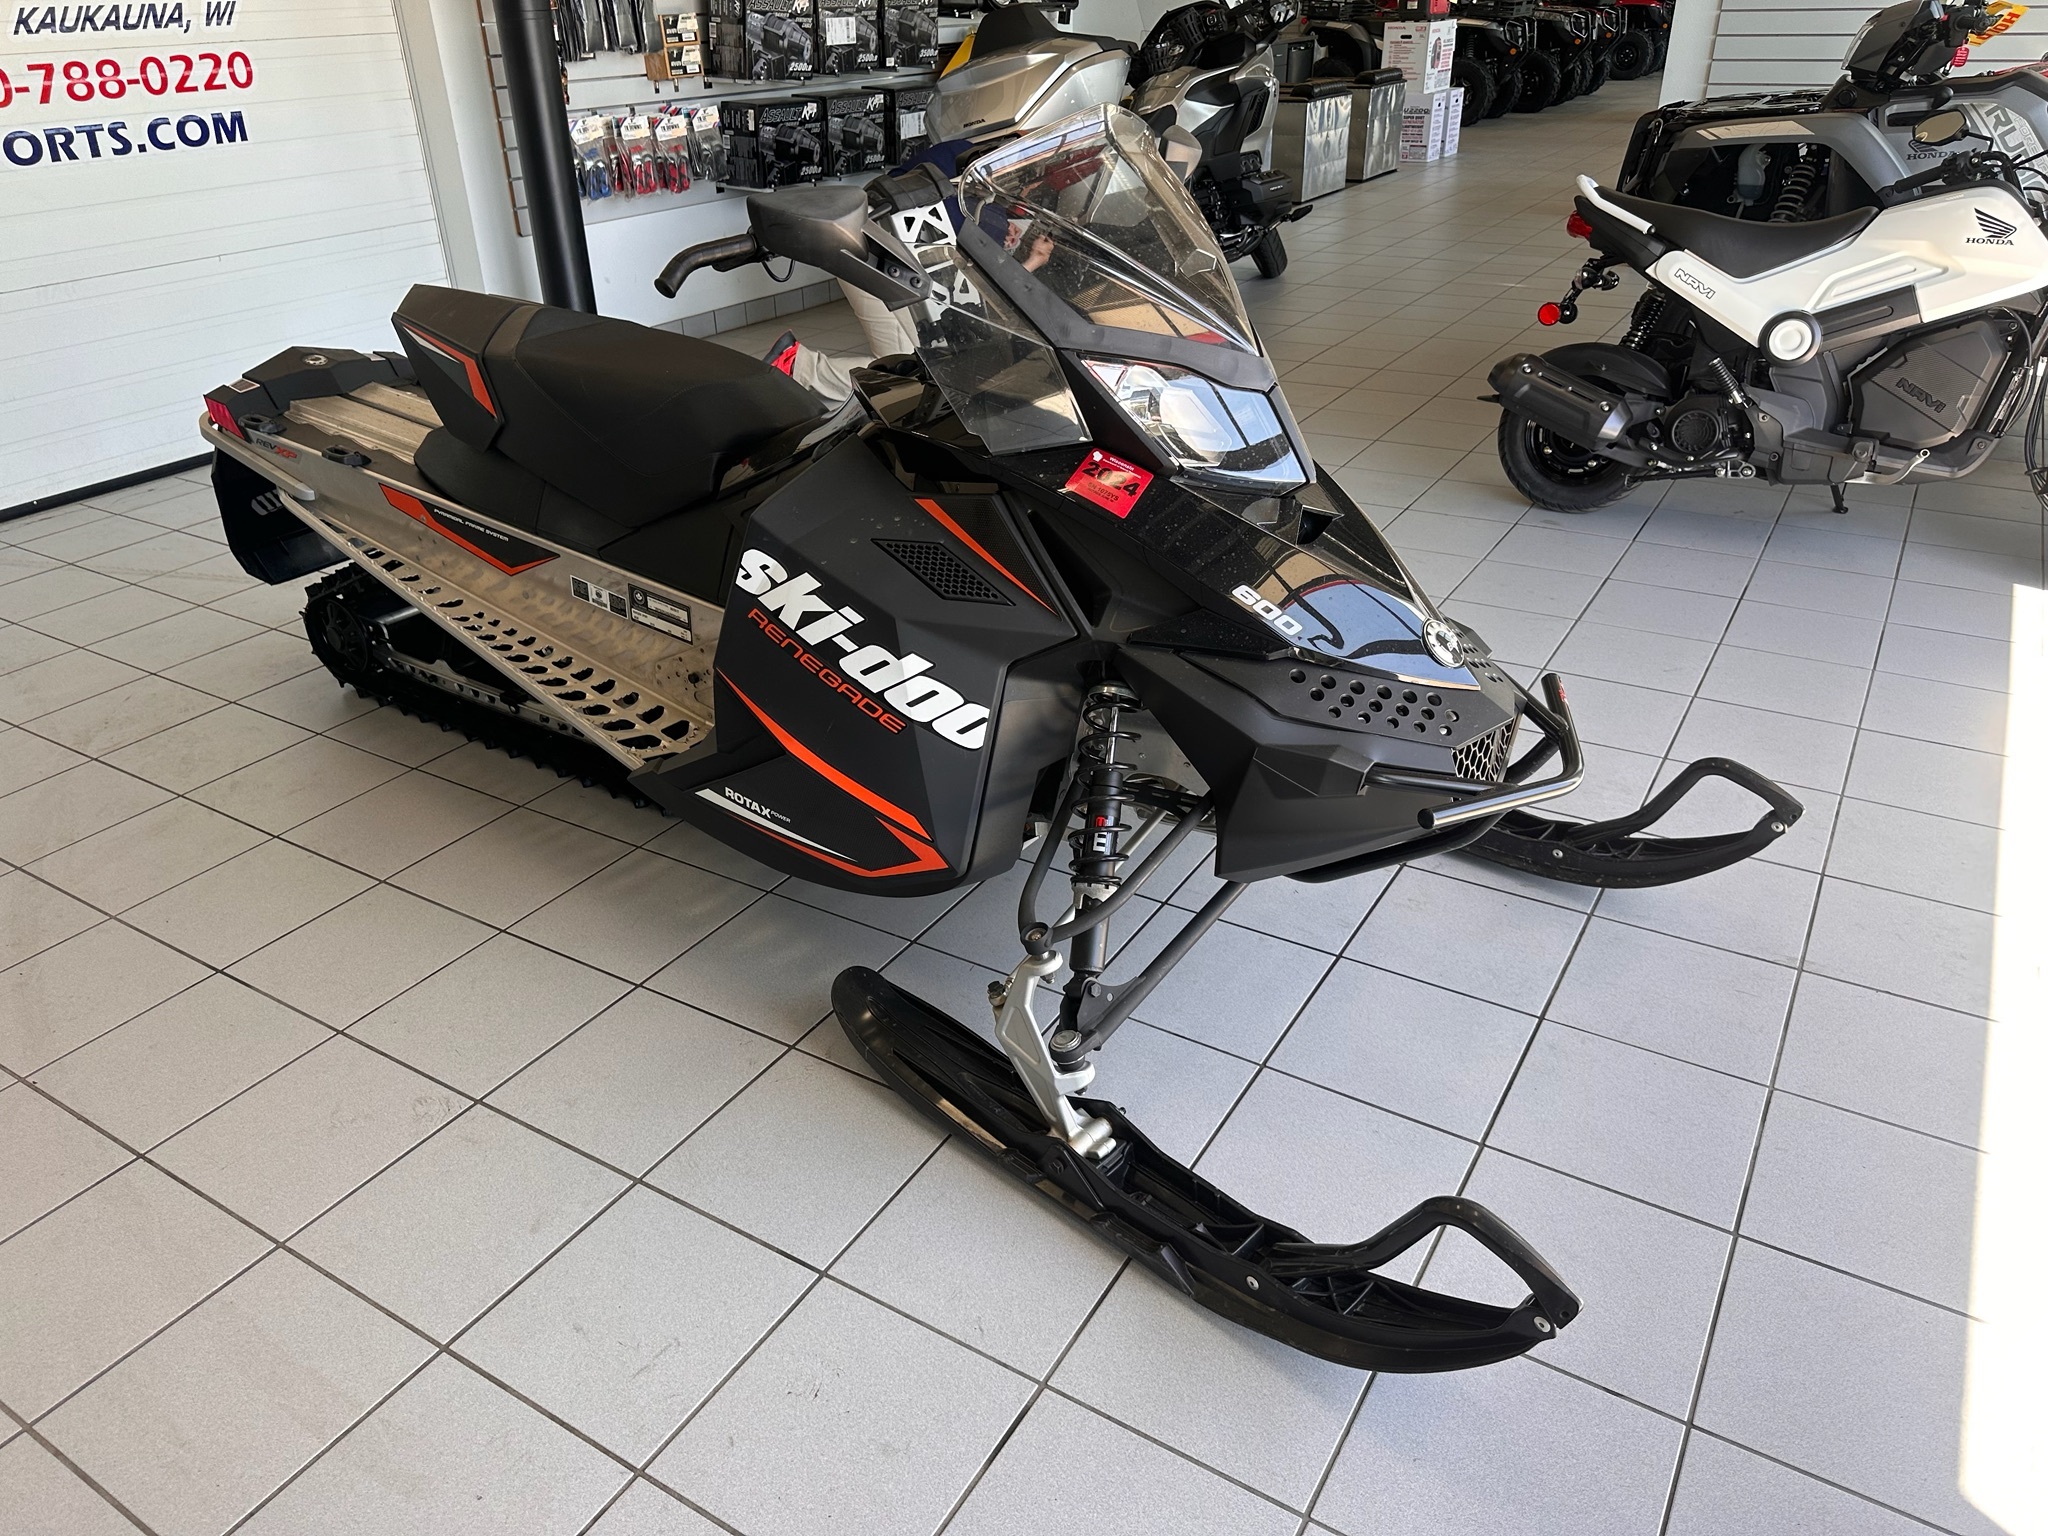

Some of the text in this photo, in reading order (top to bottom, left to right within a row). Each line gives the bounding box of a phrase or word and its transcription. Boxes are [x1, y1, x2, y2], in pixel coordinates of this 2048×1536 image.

[13, 1, 236, 35] KAUKAUNA, WI
[759, 107, 802, 123] ASSAULT
[963, 118, 986, 128] HONDA
[2, 110, 248, 166] ORTS.COM
[1965, 237, 2014, 246] HONDA
[1674, 268, 1716, 300] NAVI
[1895, 377, 1946, 413] NAVI
[1082, 461, 1140, 497] 2024
[1109, 456, 1135, 471] Wisconsin
[485, 529, 509, 541] SYSTEM
[1231, 584, 1303, 636] 600
[735, 548, 990, 749] ski-doo
[748, 608, 907, 734] RENEGADE
[725, 786, 791, 823] ROTAX POWER
